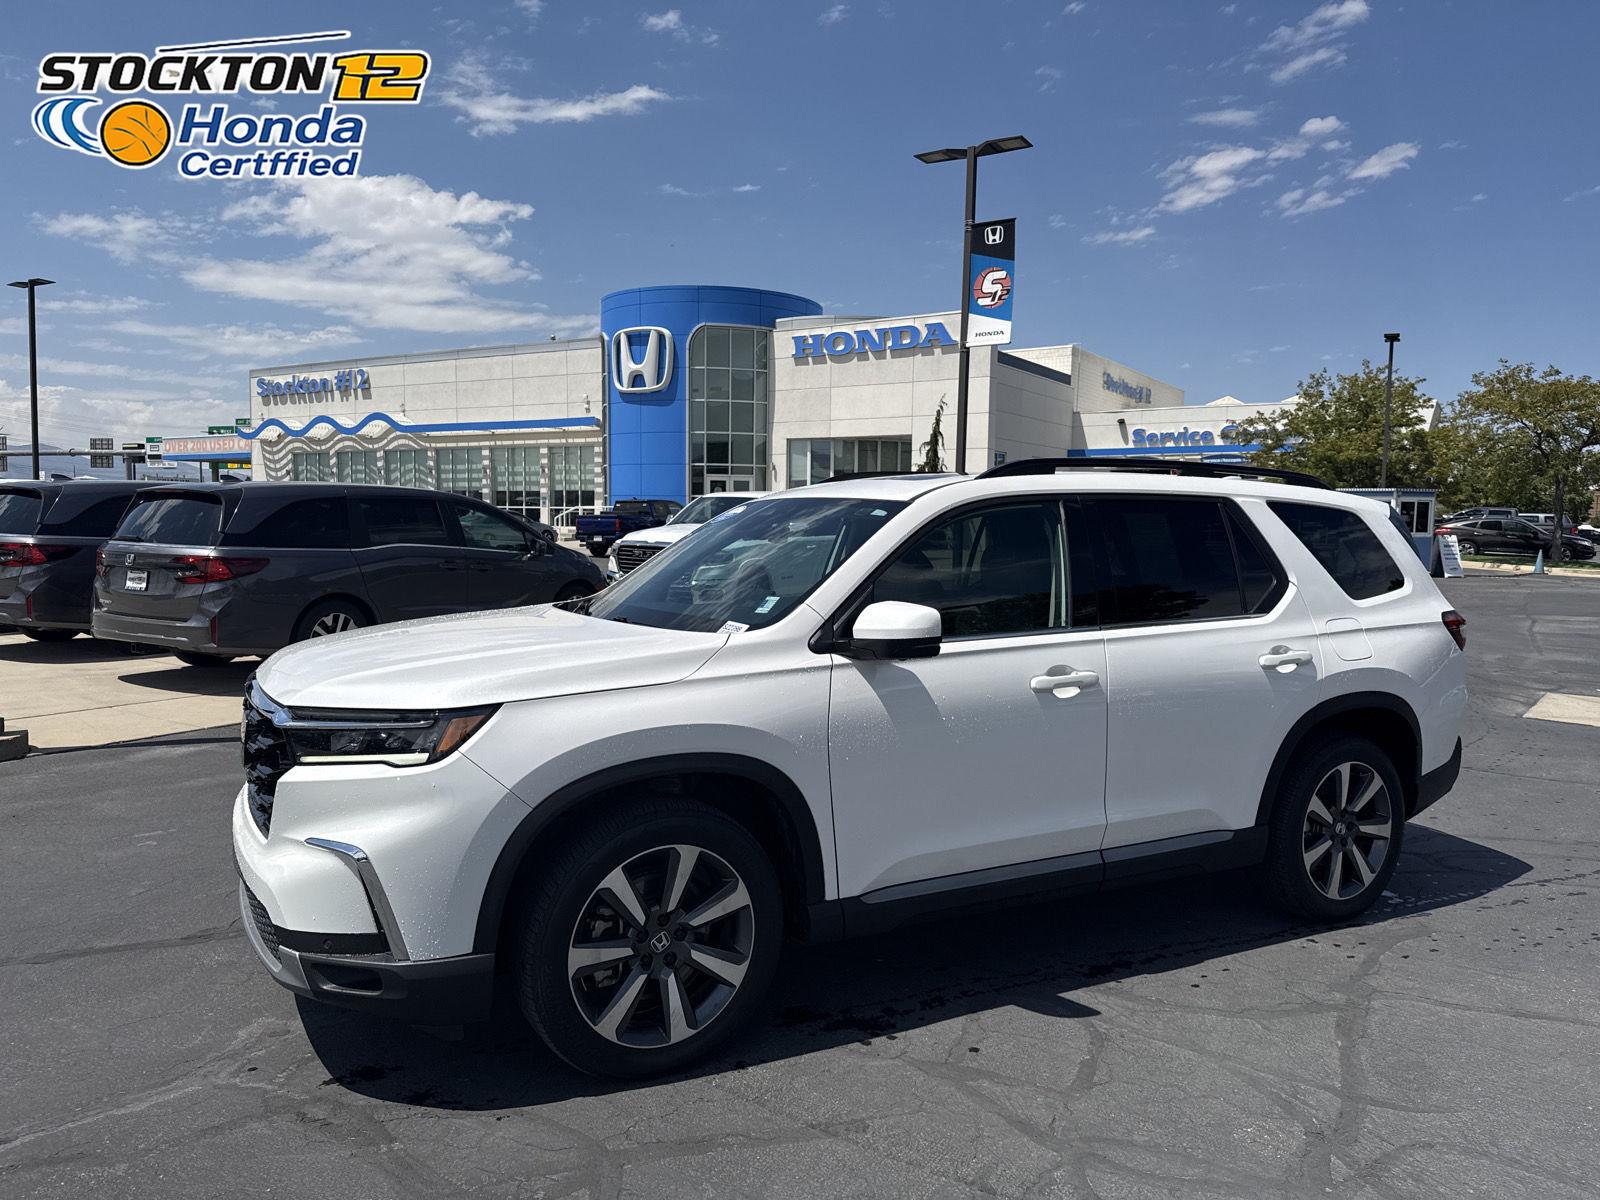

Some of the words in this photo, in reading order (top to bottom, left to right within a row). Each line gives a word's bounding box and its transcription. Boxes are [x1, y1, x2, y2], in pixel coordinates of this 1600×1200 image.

[791, 321, 958, 358] HONDA
[256, 375, 333, 397] Stockton
[335, 368, 370, 392] #12
[164, 440, 189, 453] OVER
[190, 439, 208, 452] 200
[210, 438, 235, 451] USED
[1132, 426, 1214, 445] Service
